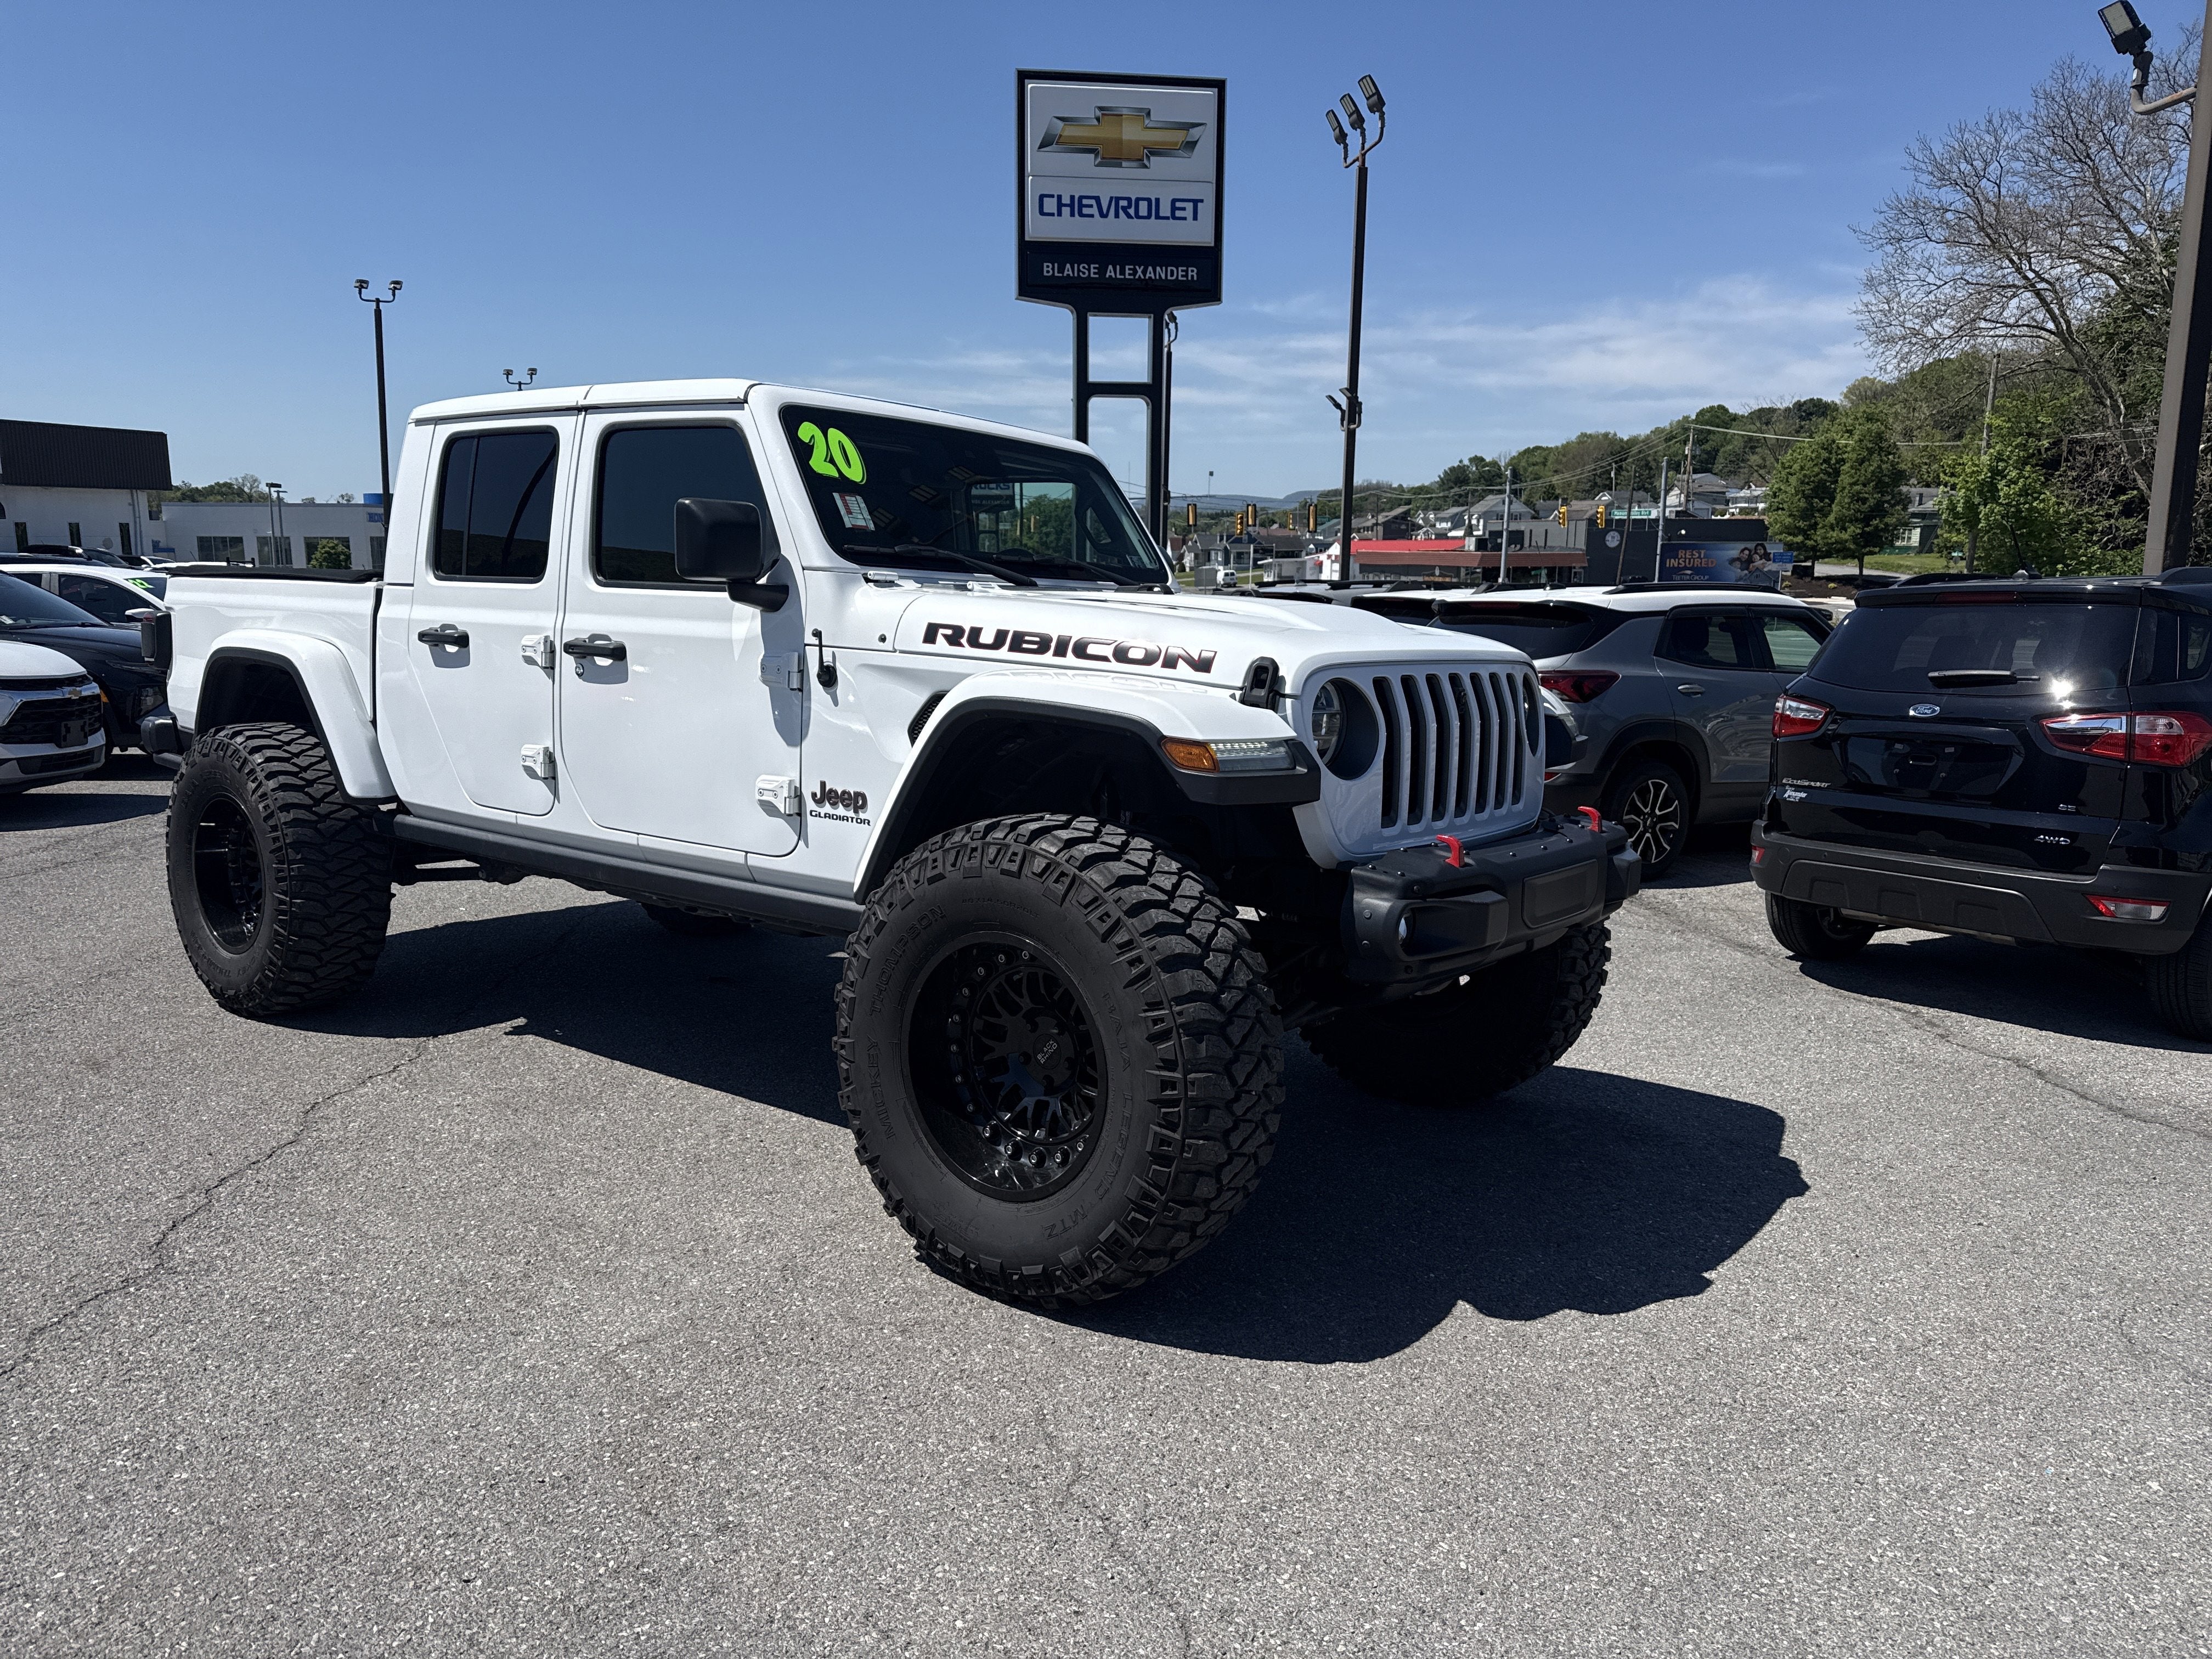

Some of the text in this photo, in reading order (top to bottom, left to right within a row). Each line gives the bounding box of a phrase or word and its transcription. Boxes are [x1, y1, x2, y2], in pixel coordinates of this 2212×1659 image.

[1038, 193, 1204, 221] CHEVROLET
[1043, 262, 1198, 281] BLAISE ALEXANDER
[798, 421, 867, 484] 20
[1666, 558, 1717, 568] INSURED
[1678, 549, 1706, 558] REST
[922, 622, 1217, 674] RUBICON
[811, 780, 868, 814] Jeep
[809, 809, 871, 826] GLADIATOR
[2034, 835, 2070, 844] 4WD
[865, 903, 948, 1141] MICKEY THOMPSON
[1101, 991, 1132, 1073] BAJA
[1037, 1039, 1054, 1060] BLACK
[1040, 1042, 1058, 1064] RHINO
[1094, 1092, 1133, 1200] LEGEND
